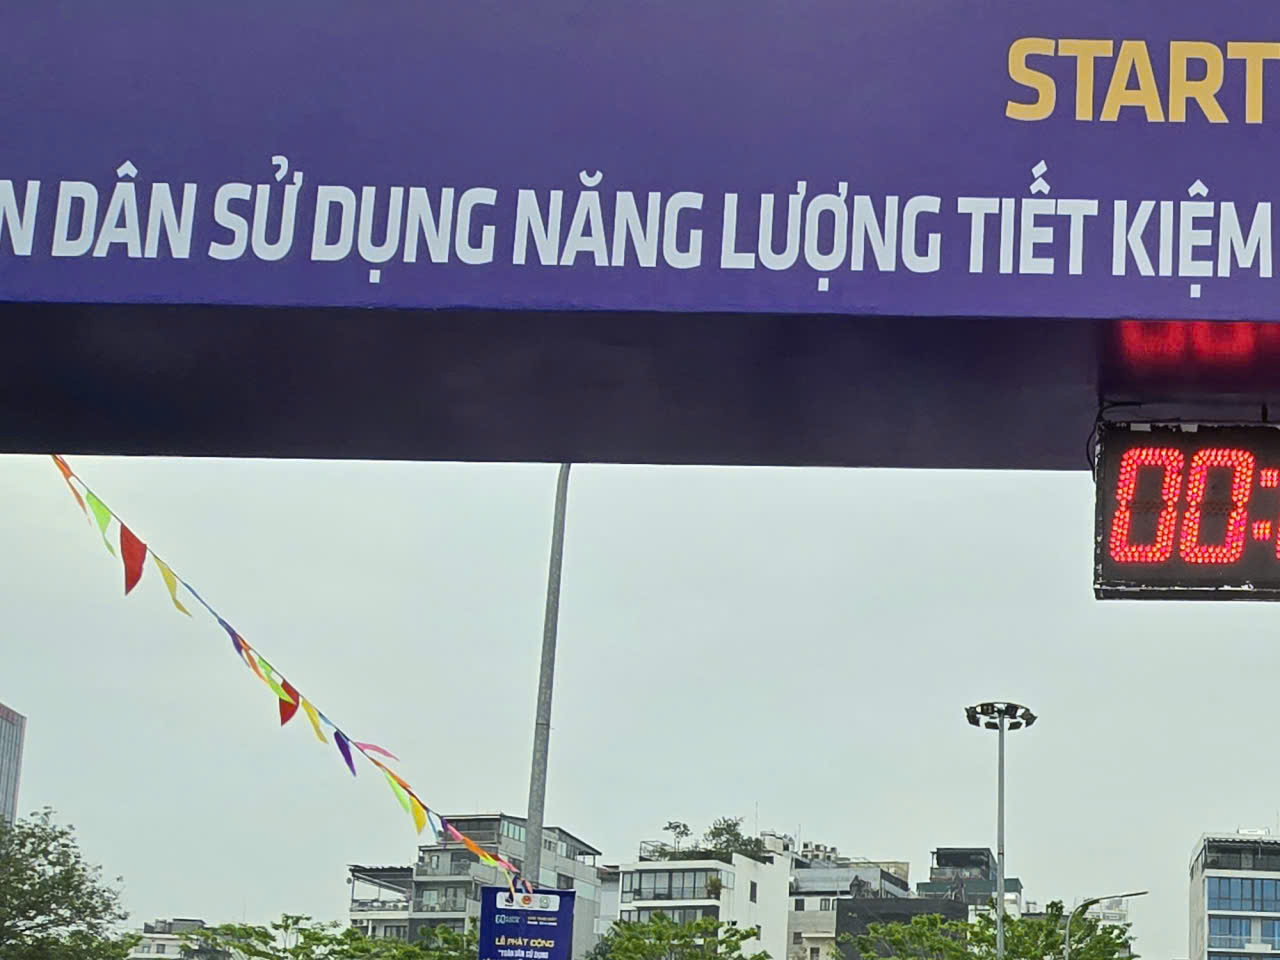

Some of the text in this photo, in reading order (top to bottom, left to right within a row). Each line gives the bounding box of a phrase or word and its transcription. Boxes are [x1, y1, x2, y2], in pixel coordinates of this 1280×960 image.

[52, 161, 197, 259] DÂN
[208, 155, 304, 262] SỬ
[310, 186, 498, 284] DỤNG
[513, 170, 704, 270] NĂNG
[721, 181, 942, 291] LƯỢNG
[958, 160, 1099, 276] TIẾT
[1112, 180, 1273, 298] KIỆM
